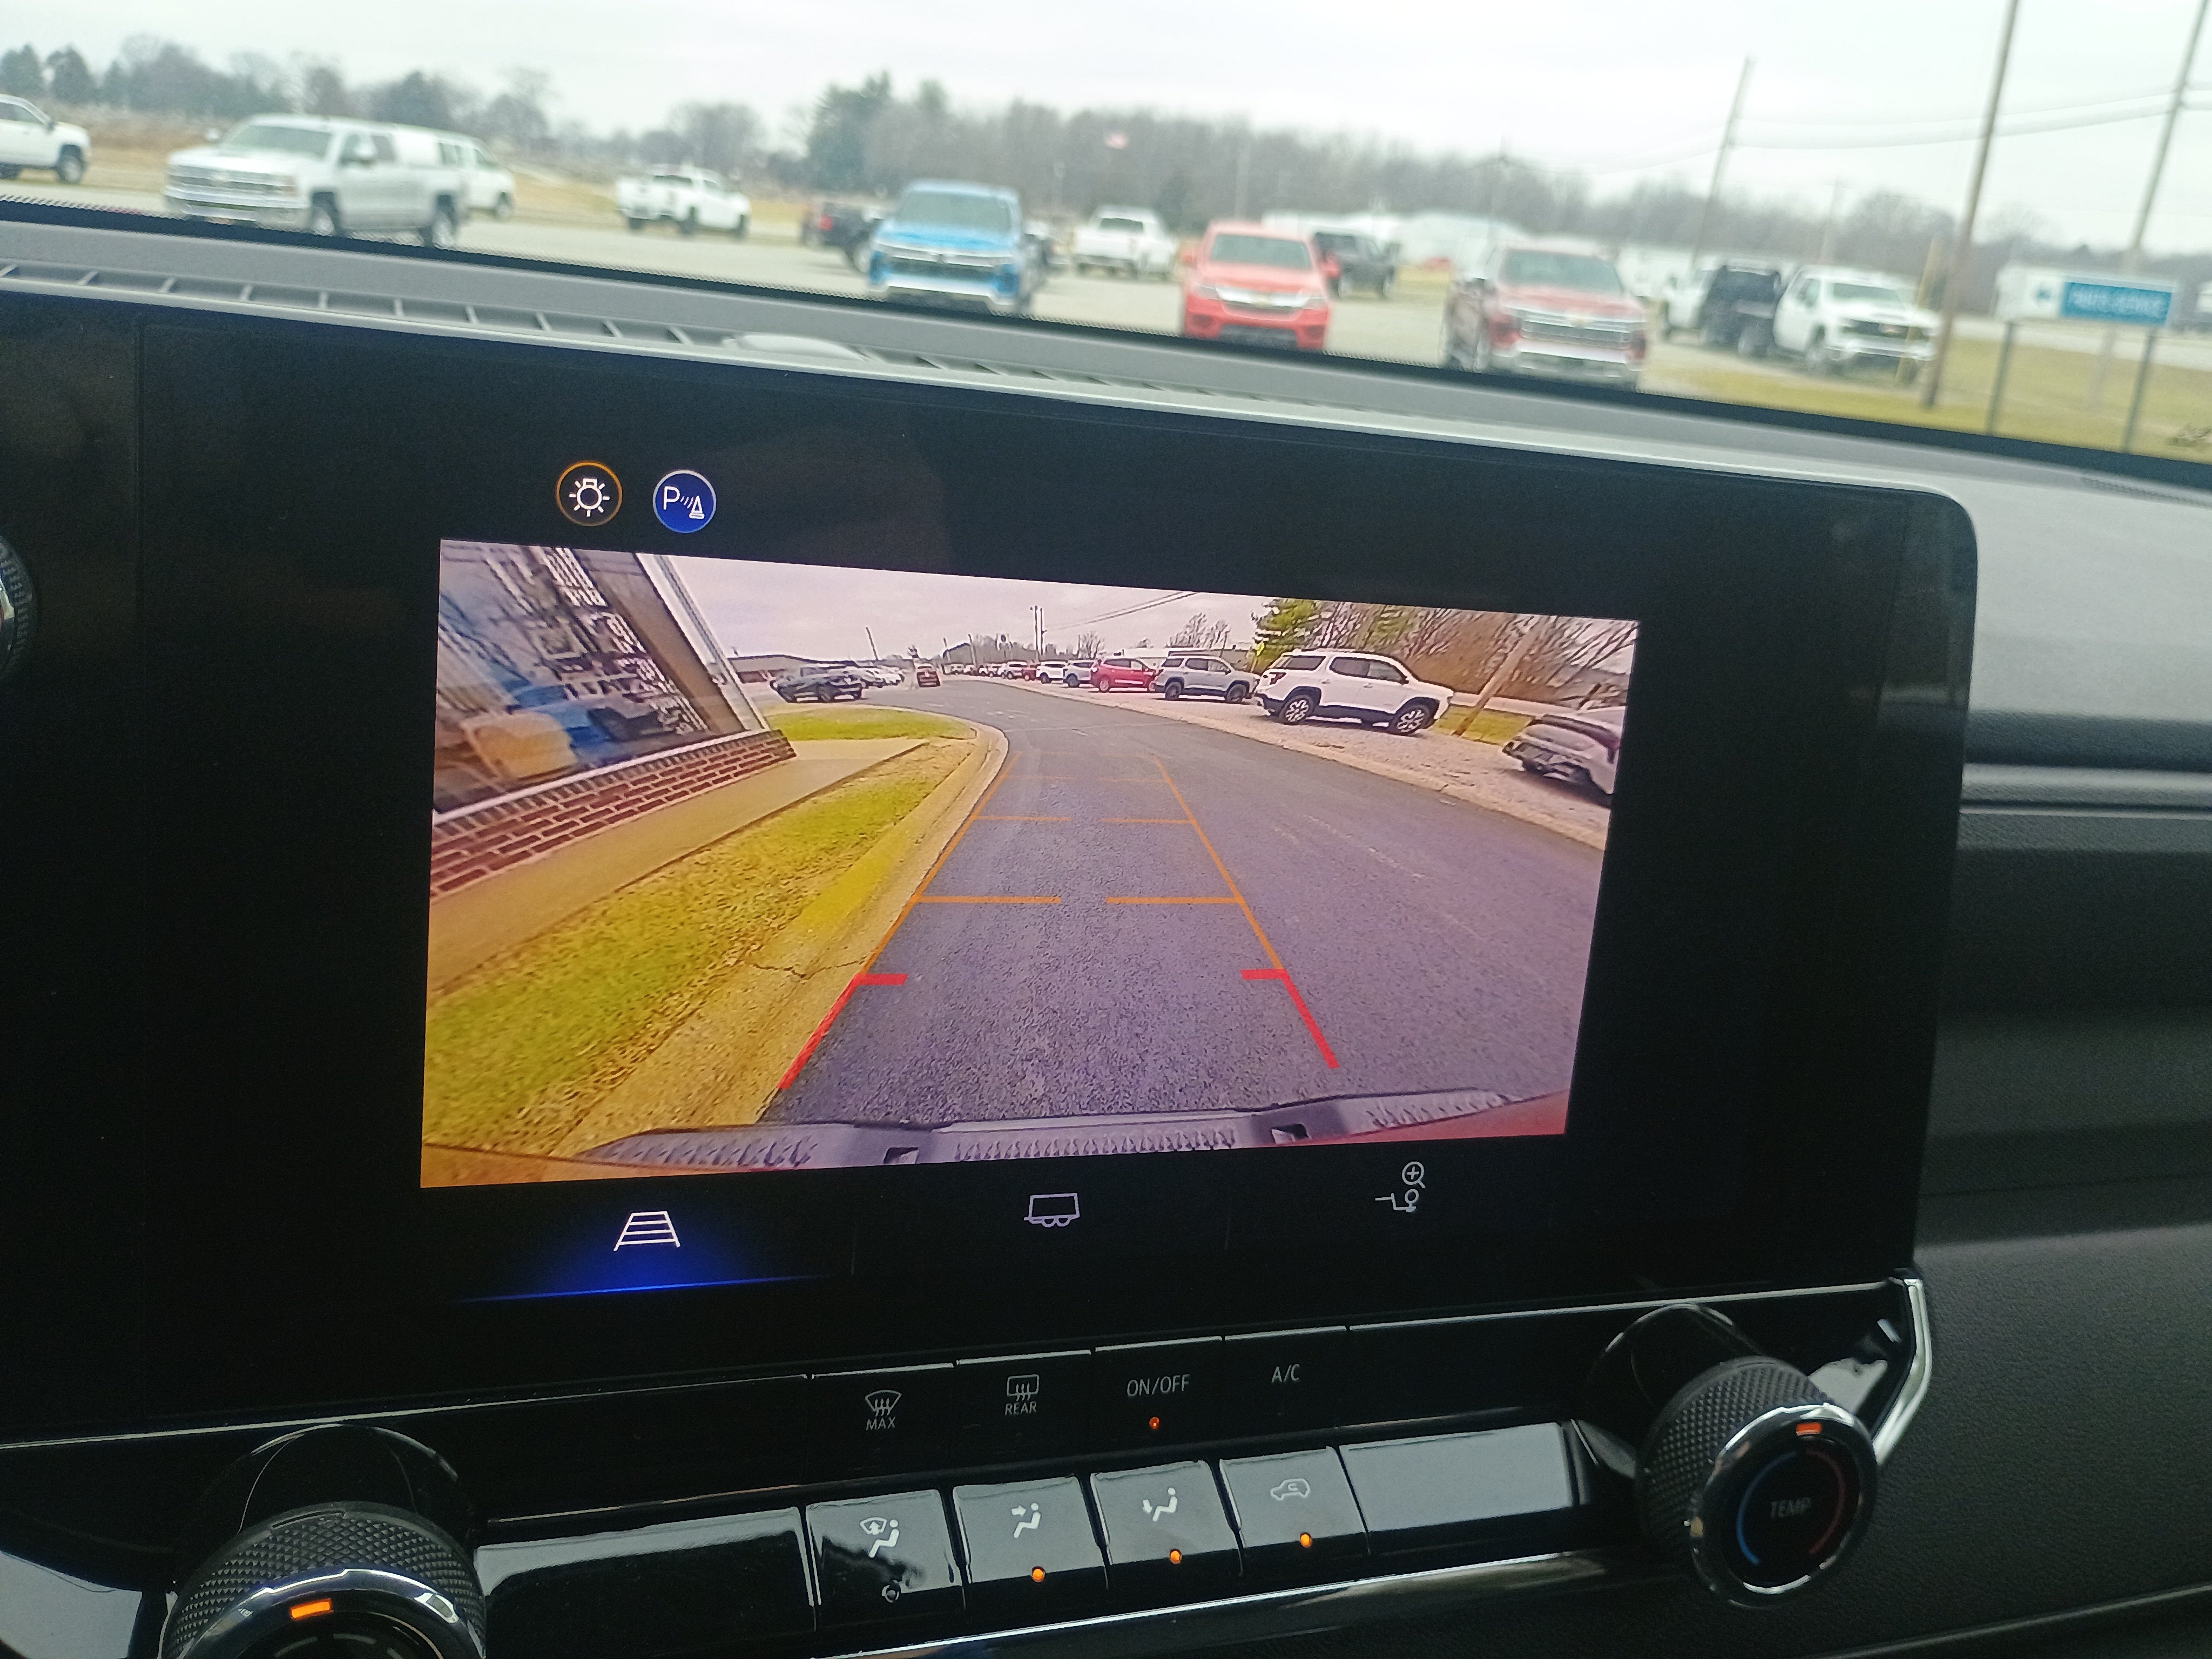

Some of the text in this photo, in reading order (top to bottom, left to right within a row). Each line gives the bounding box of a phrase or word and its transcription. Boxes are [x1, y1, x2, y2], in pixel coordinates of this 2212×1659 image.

[663, 486, 680, 510] P
[1271, 1364, 1300, 1384] A/C
[1126, 1374, 1190, 1397] ON/OFF
[1004, 1401, 1037, 1415] REAR
[865, 1416, 895, 1431] MAX
[1770, 1498, 1811, 1518] TEMP
